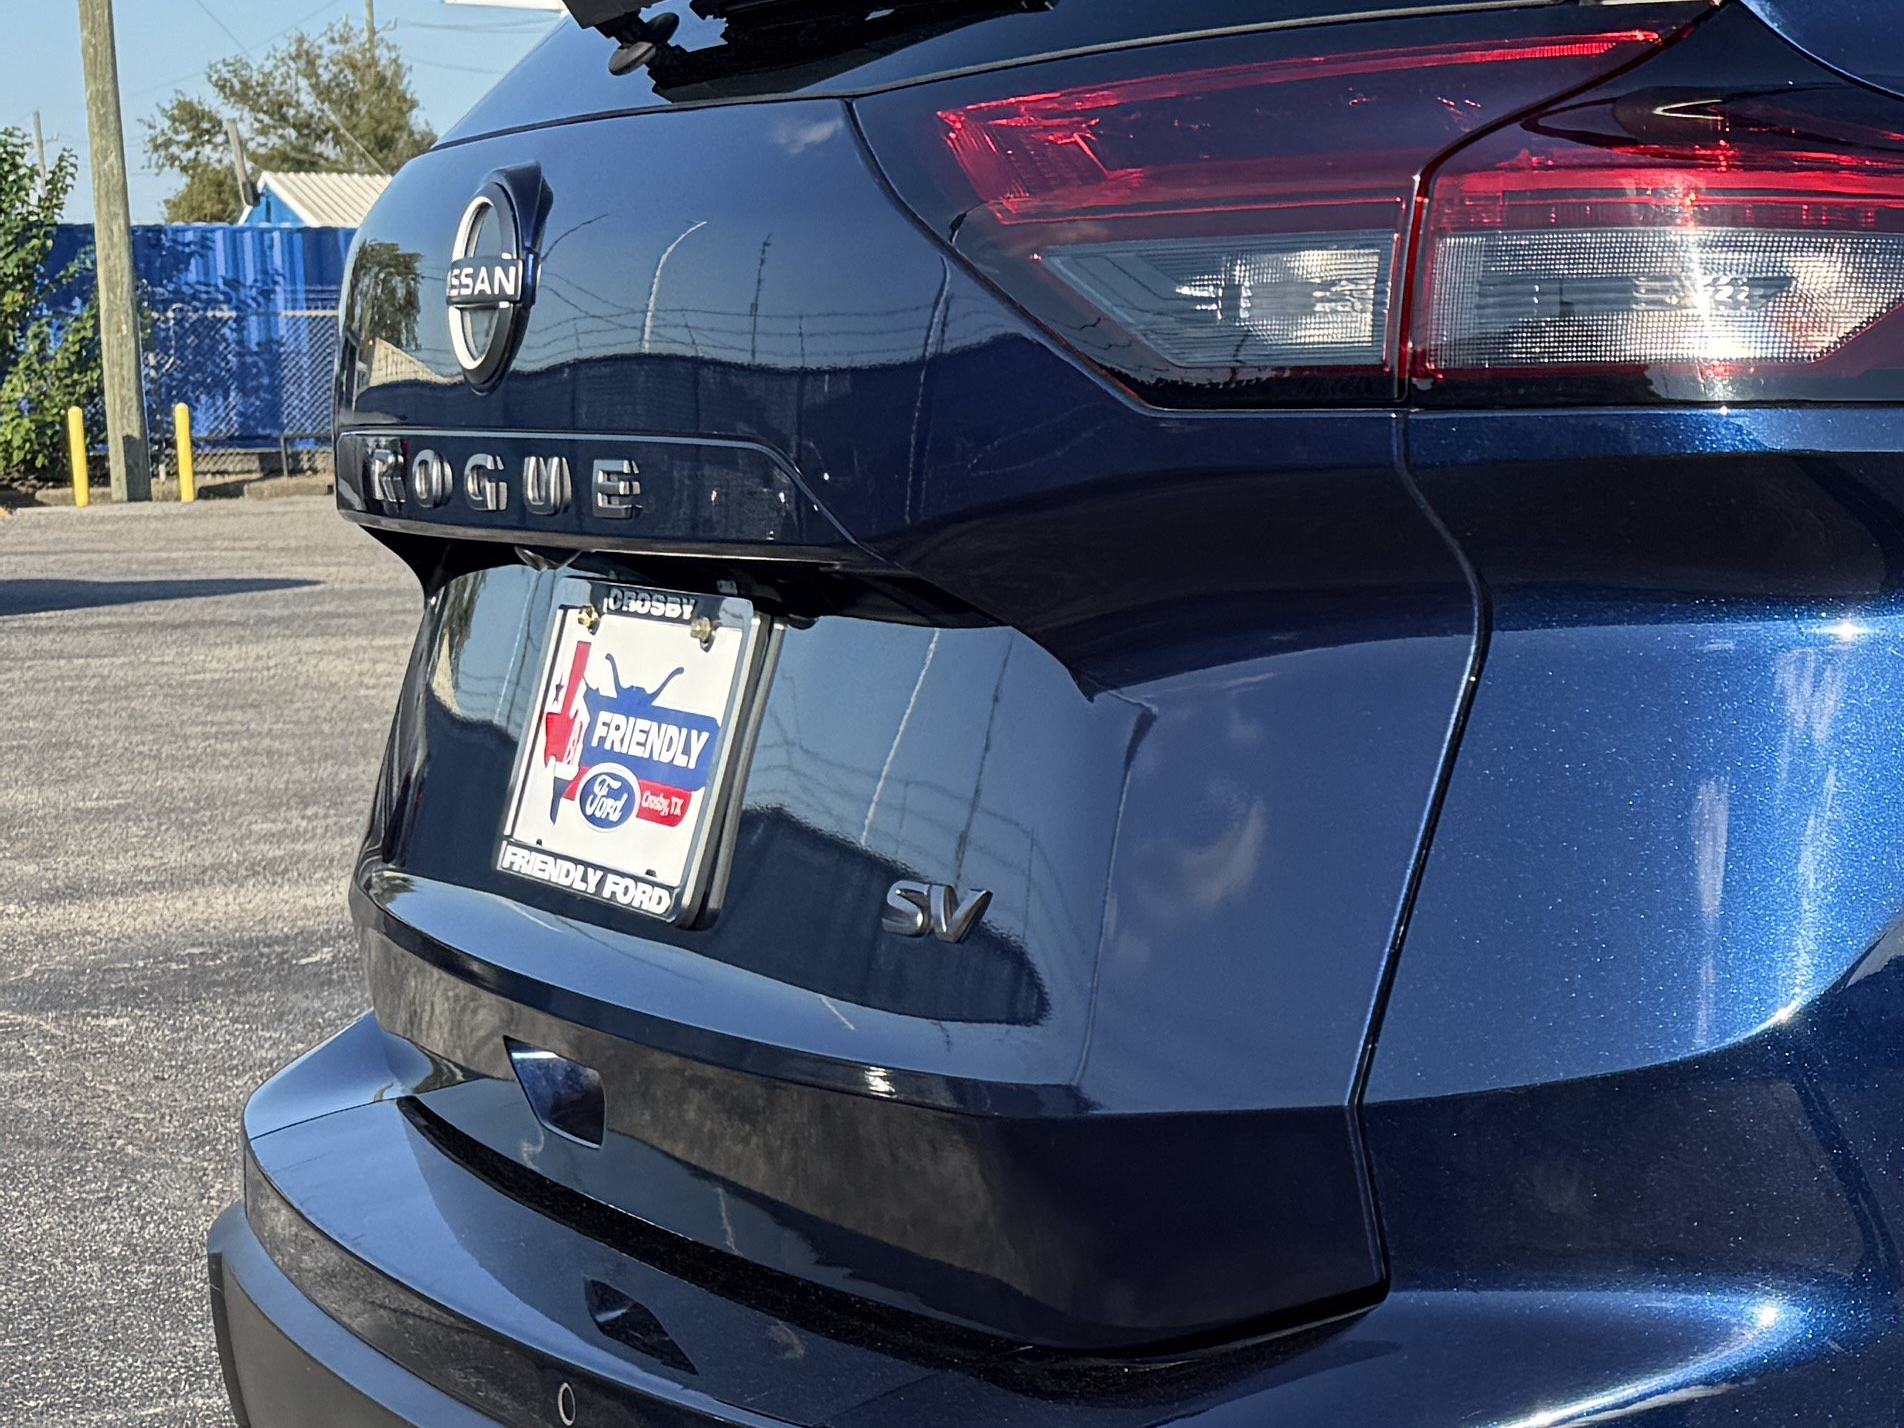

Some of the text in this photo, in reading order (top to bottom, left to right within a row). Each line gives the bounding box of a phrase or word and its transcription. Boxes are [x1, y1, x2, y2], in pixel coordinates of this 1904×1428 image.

[369, 449, 641, 519] ROGUE
[608, 588, 697, 620] CROSBY
[591, 711, 709, 769] FRIENDLY
[586, 774, 628, 822] Ford
[670, 796, 684, 816] TX
[501, 844, 671, 915] FRIENDLY FORD
[881, 880, 993, 944] SV
